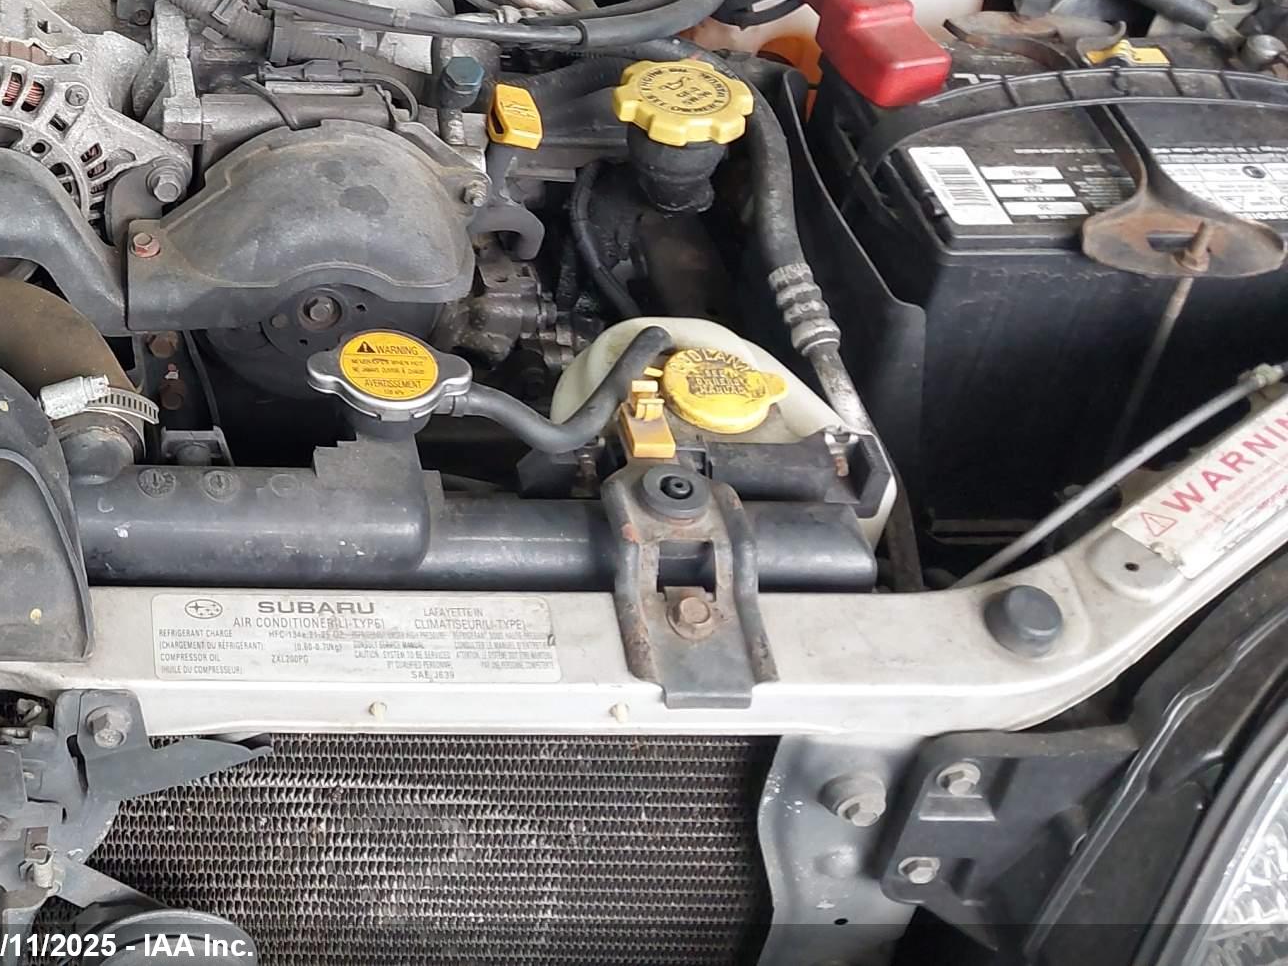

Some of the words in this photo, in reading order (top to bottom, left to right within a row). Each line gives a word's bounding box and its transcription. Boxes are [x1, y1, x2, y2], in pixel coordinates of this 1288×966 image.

[376, 345, 419, 356] WARNING
[365, 379, 422, 389] AVERTISSEMENT
[258, 601, 375, 614] SUBARU
[423, 607, 472, 617] LAFAYETTE
[233, 617, 252, 627] AIR
[209, 653, 221, 662] OIL
[411, 670, 430, 679] SAE
